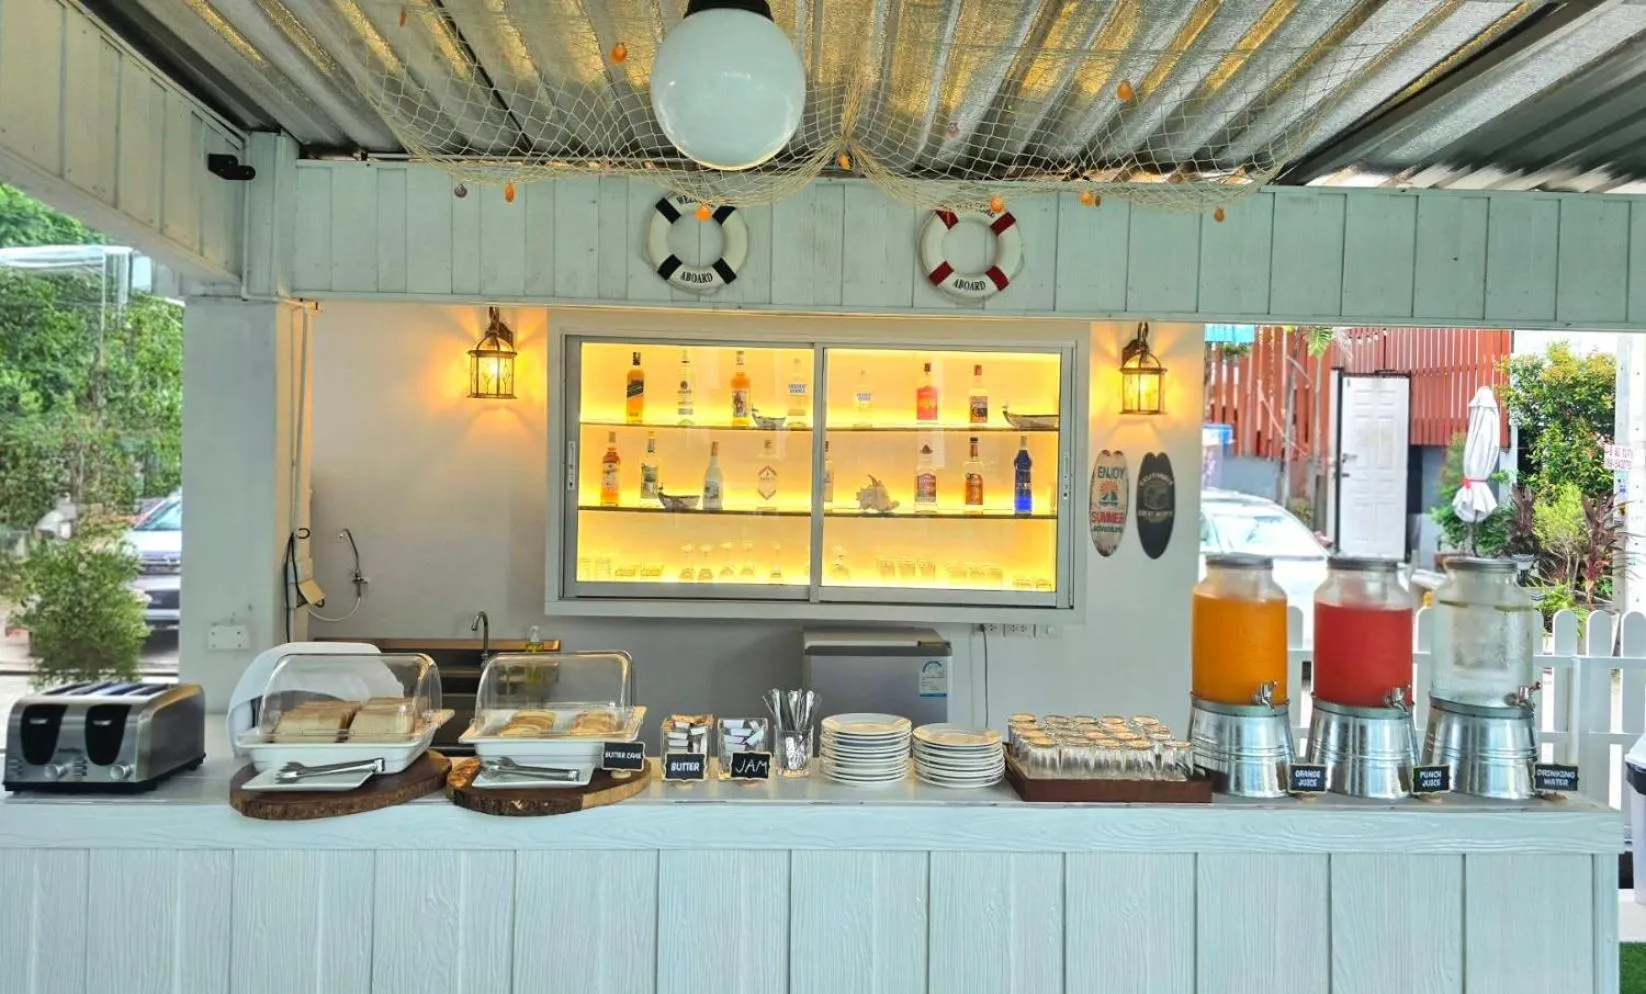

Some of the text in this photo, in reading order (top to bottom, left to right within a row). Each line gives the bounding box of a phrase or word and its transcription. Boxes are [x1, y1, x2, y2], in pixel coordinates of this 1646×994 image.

[680, 271, 713, 283] ABOARD
[952, 278, 986, 291] ABOARD
[1097, 466, 1125, 479] ENJOY
[1091, 511, 1125, 524] SUMMER
[604, 750, 626, 759] BUTTER
[670, 762, 700, 772] BUTTER
[735, 759, 768, 775] JAM
[1295, 769, 1321, 778] ORANGE
[1420, 770, 1442, 779] PUNCH
[1536, 768, 1576, 779] DRINKING
[1298, 778, 1317, 788] JUICE
[1422, 779, 1441, 788] JUICE
[1543, 778, 1569, 787] WATER
